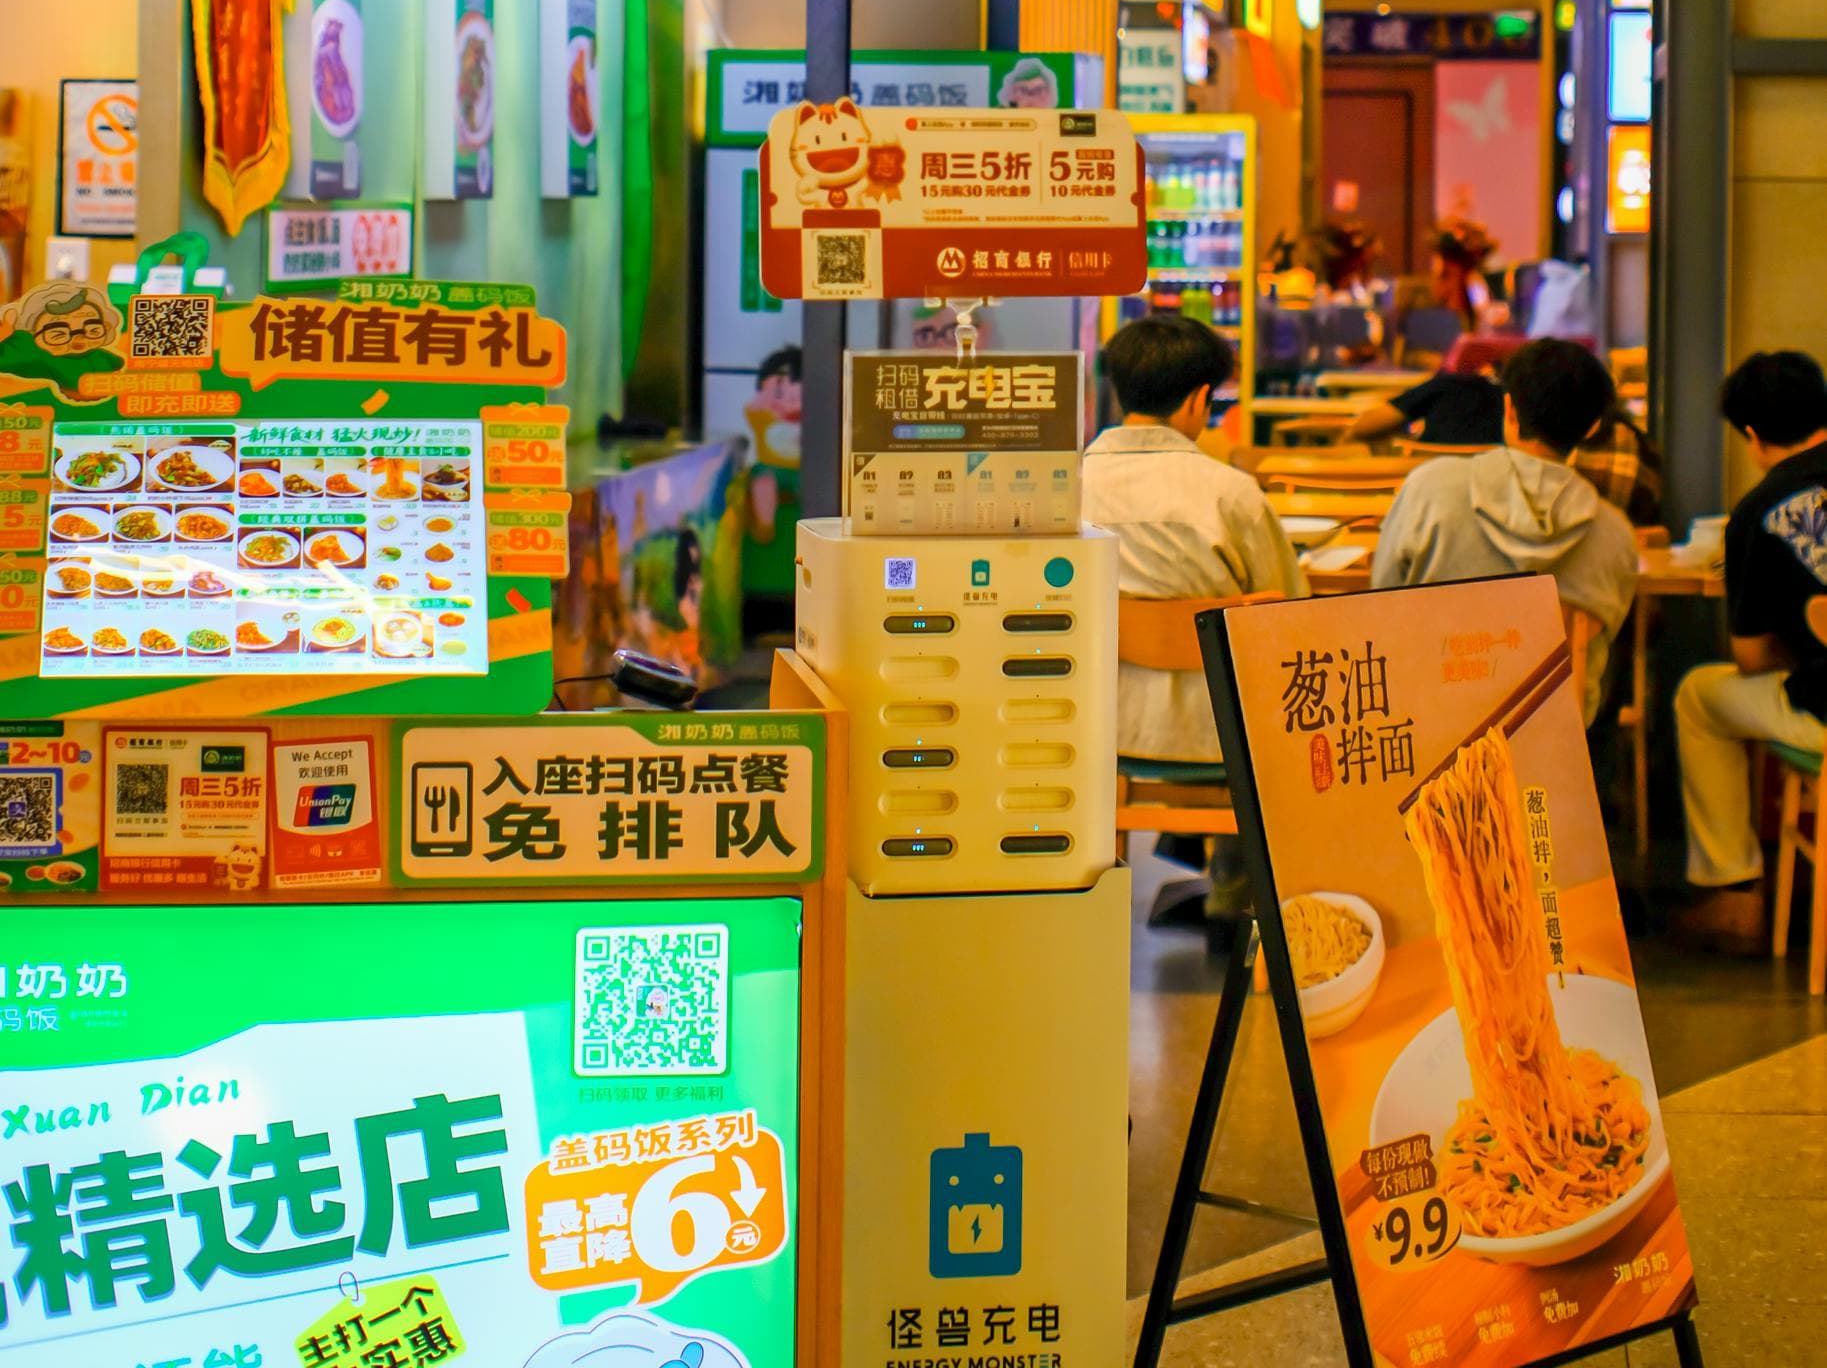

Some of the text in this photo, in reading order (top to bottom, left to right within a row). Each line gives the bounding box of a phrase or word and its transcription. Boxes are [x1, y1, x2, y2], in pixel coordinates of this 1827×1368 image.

[920, 151, 1032, 181] 周三5折
[972, 249, 1112, 269] 招商银行 信用卡
[249, 302, 553, 368] 储值有礼
[126, 394, 235, 414] 即充即送
[875, 388, 919, 410] 租借
[876, 364, 1057, 410] 扫码 充电宝
[240, 426, 325, 446] 新鲜食材
[1281, 641, 1390, 733] 葱油
[291, 749, 353, 762] We Accept
[298, 764, 349, 779] 欢迎使用
[1337, 717, 1415, 786] 拌面
[179, 777, 261, 797] 周三5折
[481, 752, 789, 797] 入座扫码点餐
[299, 794, 352, 809] UnionPay
[481, 800, 798, 863] 免排队
[0, 963, 129, 1000] 奶奶
[1, 1075, 240, 1140] Xuan Dian
[579, 1085, 724, 1104] 扫码领取 更多福利
[554, 1112, 754, 1170] 盖码饭系列
[1367, 1139, 1430, 1174] 每份现做
[0, 1093, 511, 1330] 精选店
[537, 1192, 629, 1238] 最高
[630, 1153, 732, 1273] 6
[1372, 1197, 1448, 1265] ¥9.9
[540, 1228, 632, 1275] 直降
[1613, 1251, 1669, 1285] 湘奶奶
[299, 1285, 435, 1366] 主打一个
[886, 1302, 1061, 1350] 怪兽充电
[967, 1353, 1062, 1368] MONSTER
